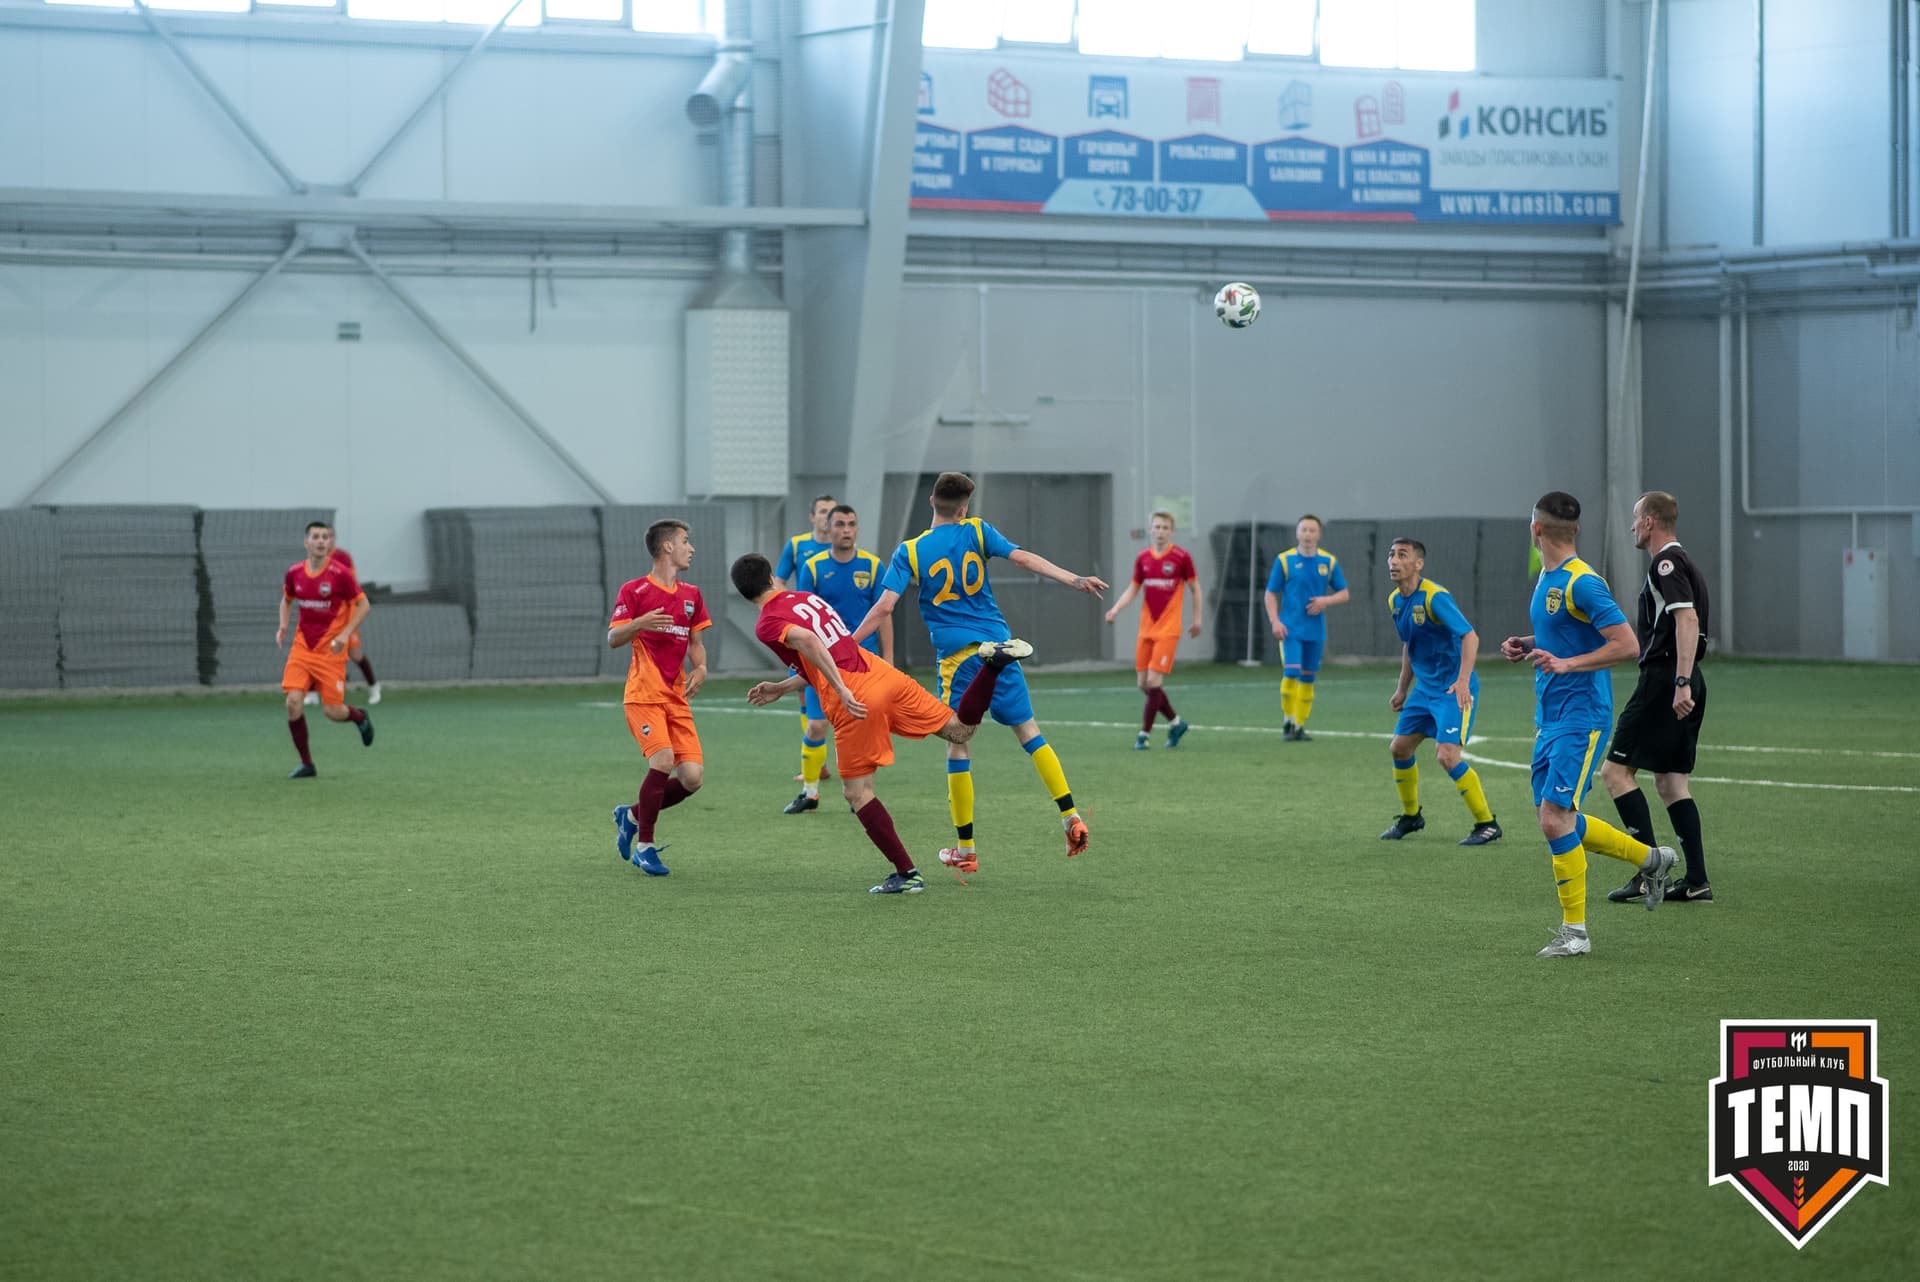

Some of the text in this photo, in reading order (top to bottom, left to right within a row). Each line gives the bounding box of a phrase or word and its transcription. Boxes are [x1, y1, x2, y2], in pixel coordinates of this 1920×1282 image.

[1477, 105, 1608, 137] КОНСИБ
[1111, 186, 1203, 213] 73-00-37
[928, 550, 985, 606] 20
[792, 594, 851, 649] 23
